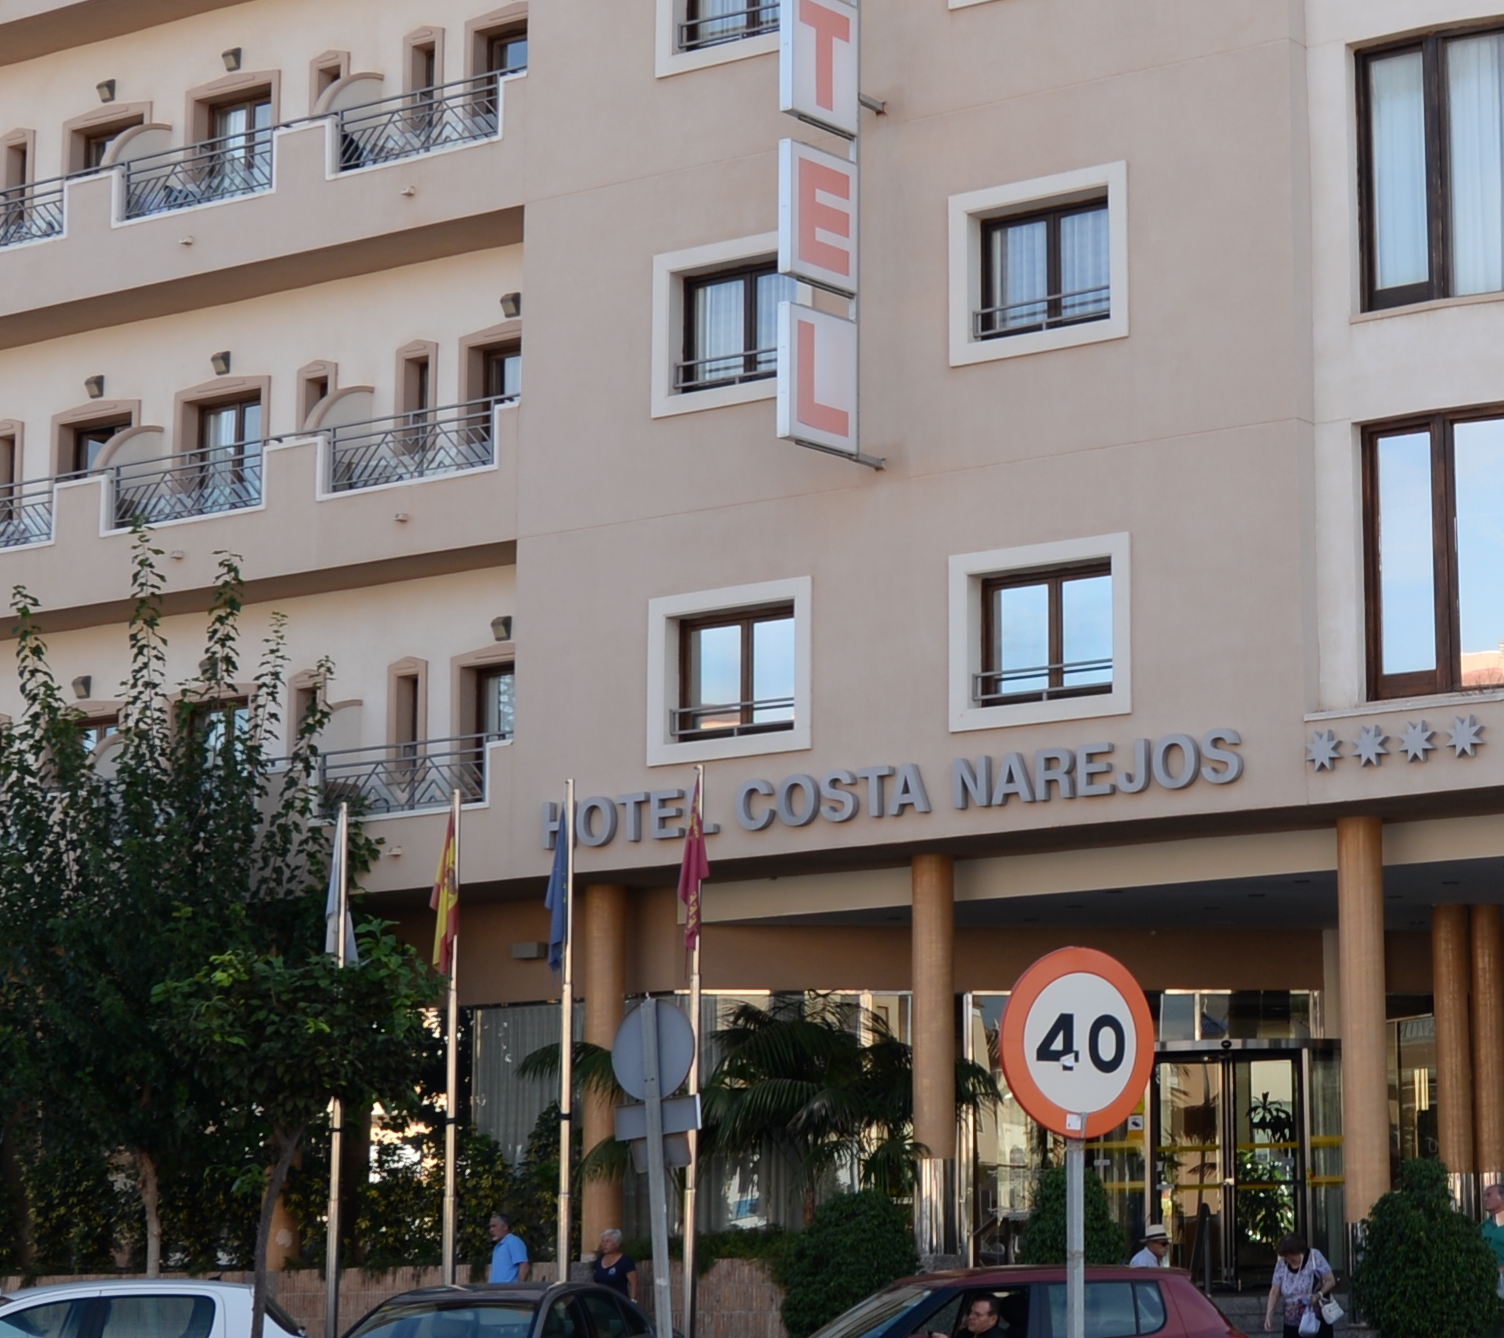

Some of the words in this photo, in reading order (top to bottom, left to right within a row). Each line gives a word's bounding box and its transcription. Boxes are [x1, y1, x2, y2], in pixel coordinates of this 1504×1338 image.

[736, 763, 931, 831] COSTA
[952, 727, 1244, 811] NAREJOS
[1035, 1012, 1126, 1074] 40
